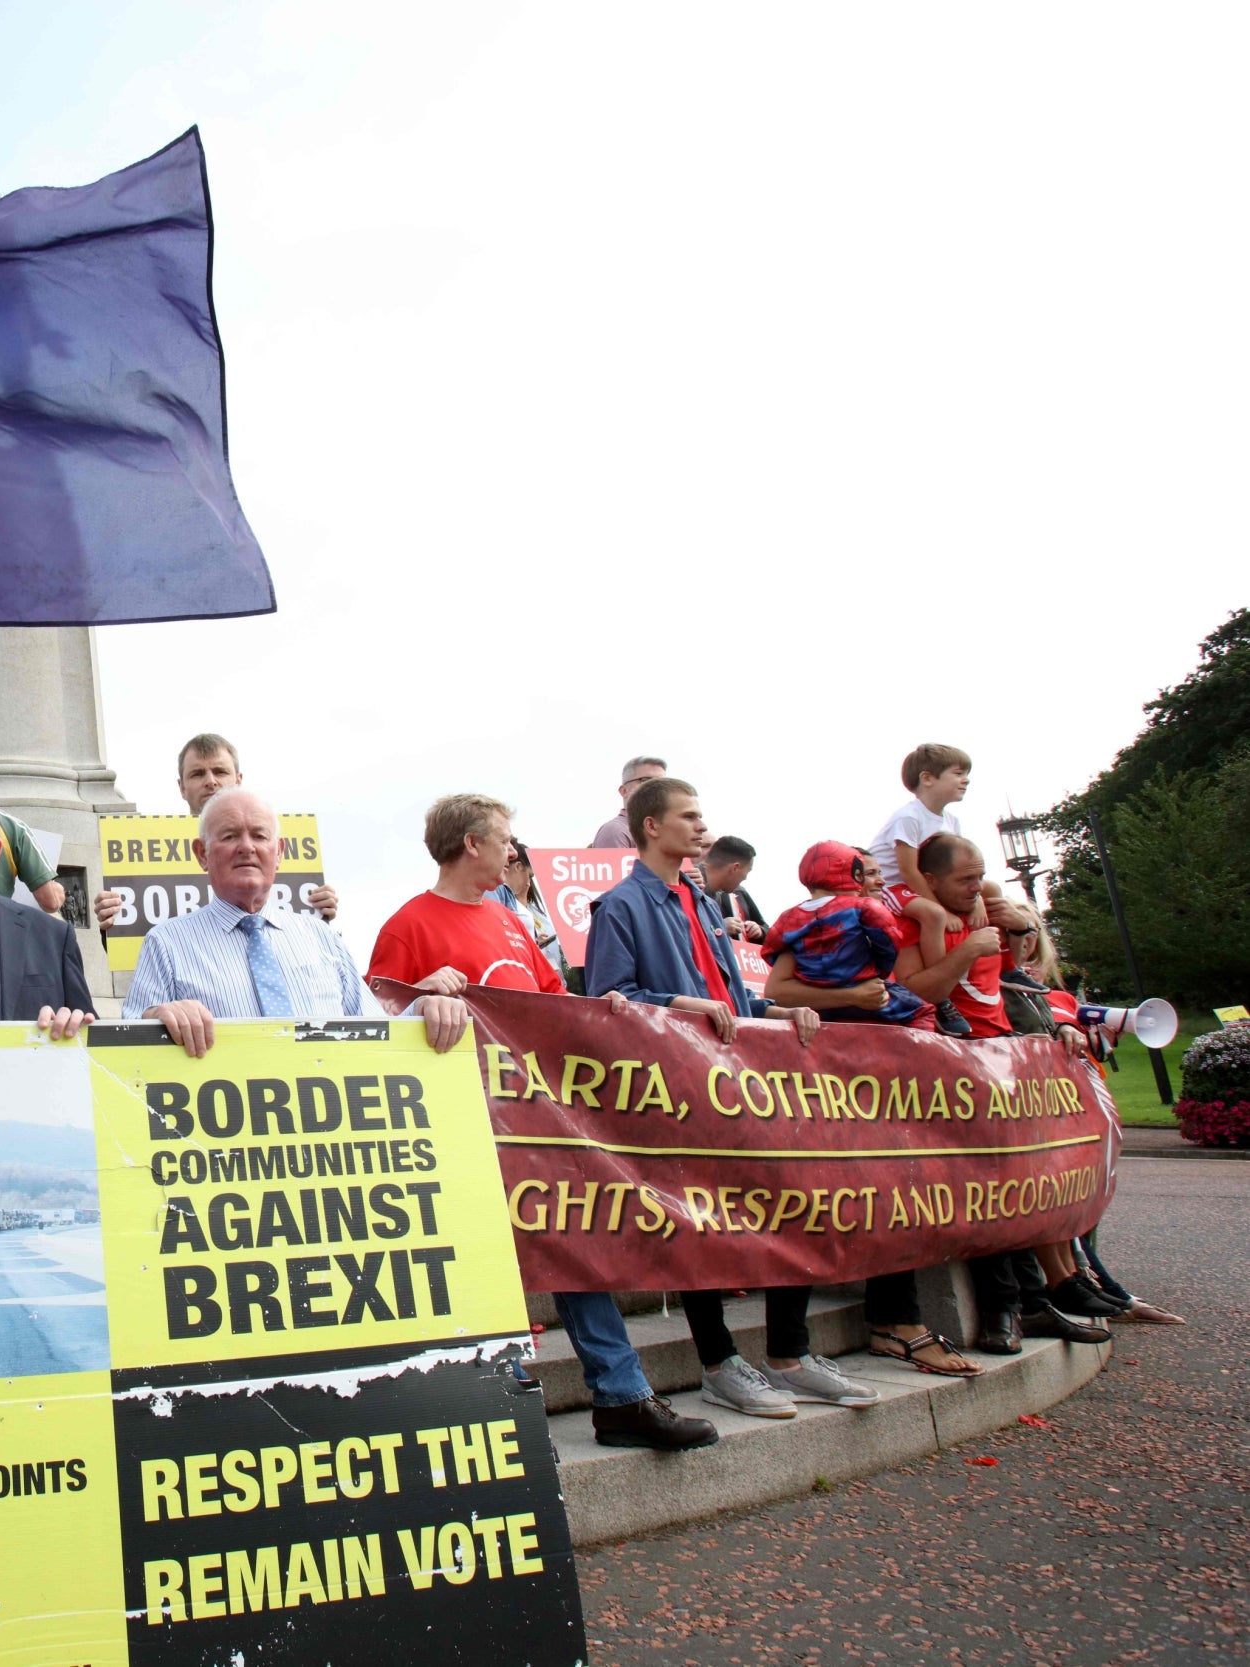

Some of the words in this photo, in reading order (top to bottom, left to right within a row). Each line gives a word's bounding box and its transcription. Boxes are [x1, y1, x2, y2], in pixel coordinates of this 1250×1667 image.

[107, 838, 192, 863] BREXI
[552, 855, 613, 881] Sinn
[145, 1074, 432, 1140] BORDER
[483, 1043, 690, 1121] EARTA,
[707, 1065, 976, 1120] COTHROMAS
[151, 1138, 437, 1186] COMMUNITIES
[159, 1181, 442, 1255] AGAINST
[509, 1179, 676, 1239] GHTS,
[683, 1185, 877, 1233] RESPECT
[888, 1183, 955, 1230] AND
[965, 1165, 1098, 1223] RECOGNITION
[163, 1246, 456, 1340] BREXIT
[141, 1432, 403, 1522] RESPECT
[416, 1419, 525, 1488] THE
[144, 1533, 386, 1626] REMAIN
[397, 1512, 544, 1591] VOTE
